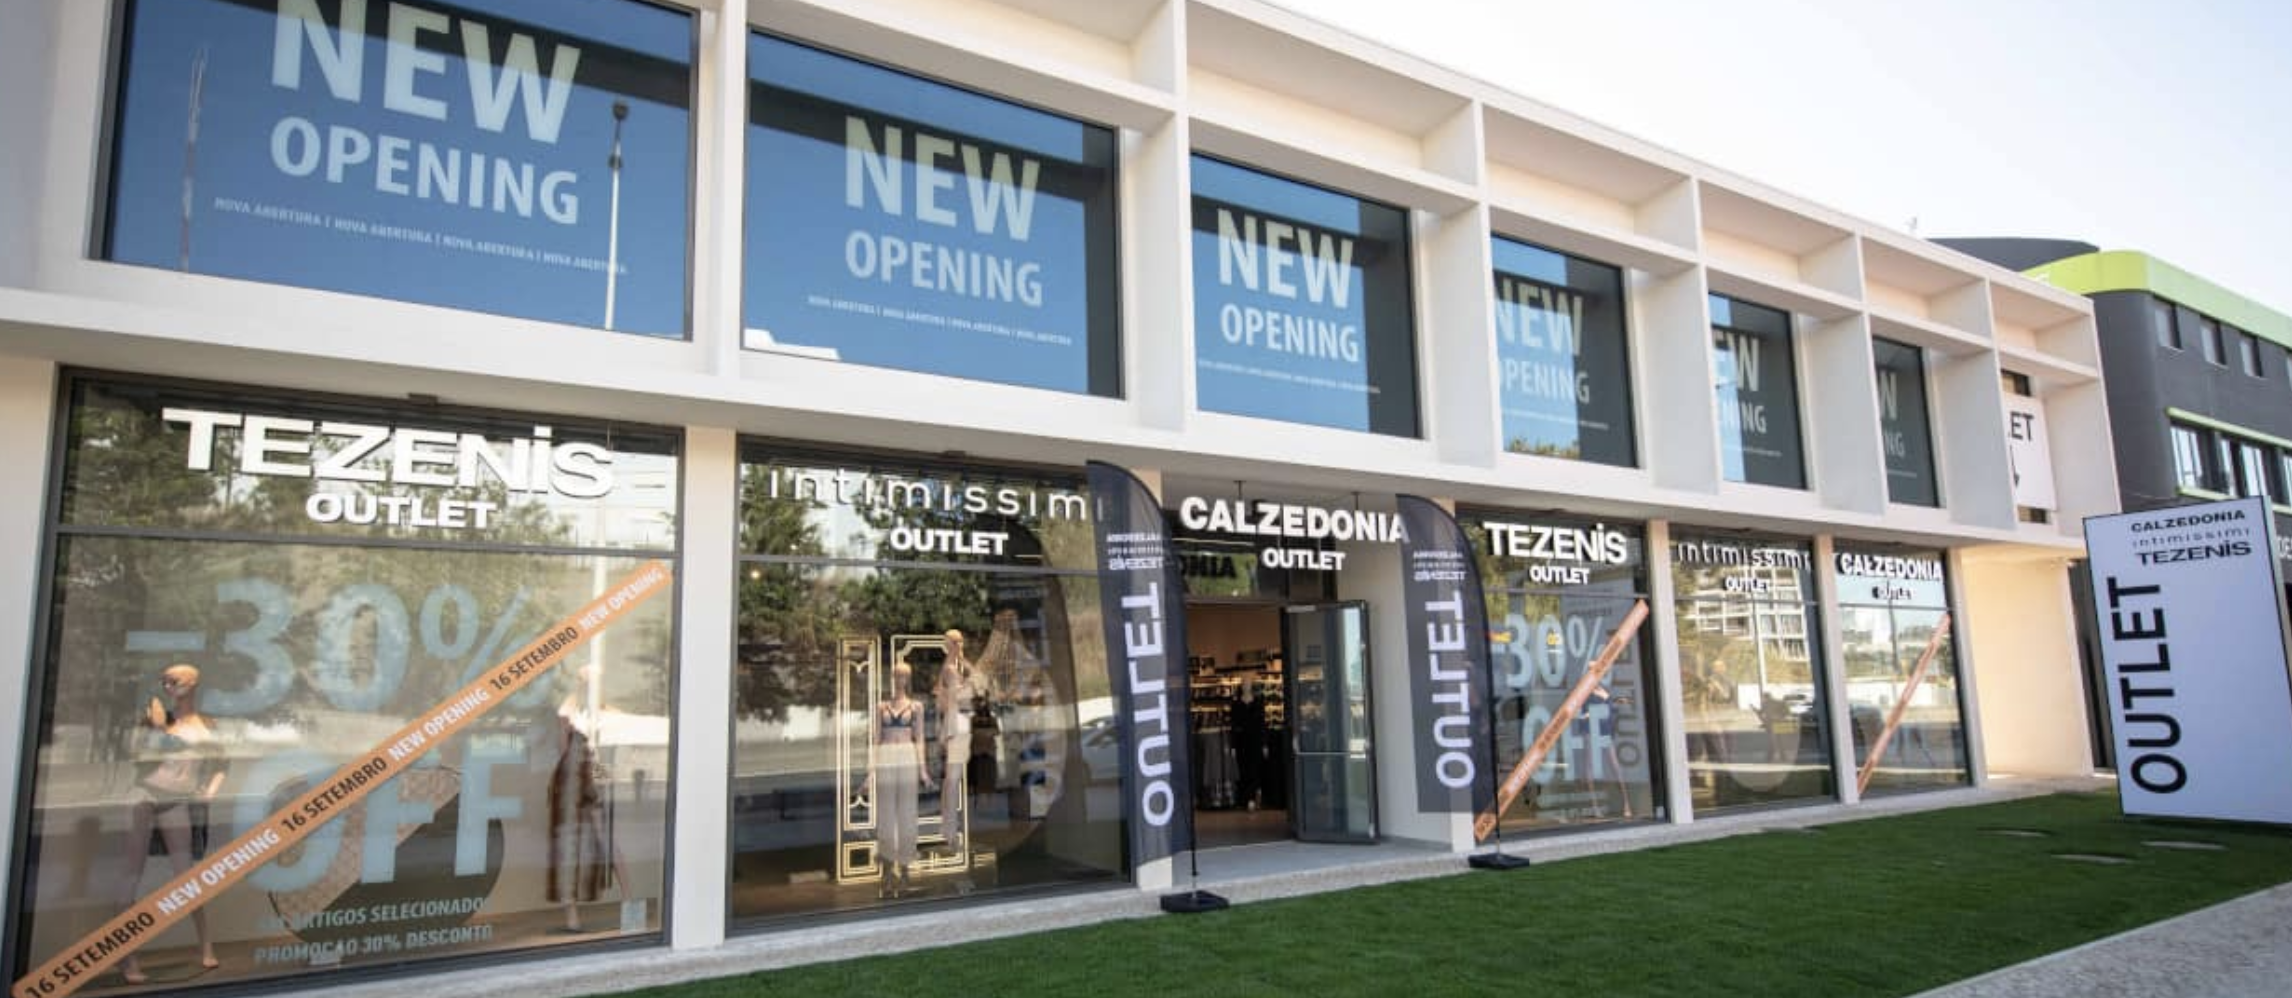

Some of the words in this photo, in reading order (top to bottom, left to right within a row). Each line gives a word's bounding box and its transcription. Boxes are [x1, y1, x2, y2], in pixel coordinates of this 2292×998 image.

[271, 0, 581, 145] NEW
[270, 117, 578, 224] OPENING
[846, 115, 1040, 242] NEW
[214, 197, 250, 213] NOVA
[335, 218, 367, 233] NOVA
[845, 230, 1043, 308] OPENING
[1217, 208, 1353, 309] NEW
[1220, 302, 1359, 362] OPENING
[1499, 357, 1590, 404] PENING
[306, 494, 498, 529] OUTLET
[769, 469, 1103, 521] intimissimi
[890, 525, 1008, 556] OUTLET
[1180, 496, 1410, 544] CALZEDONIA
[2131, 510, 2246, 533] CALZEDONIA
[2132, 527, 2250, 548] intimissimi
[1262, 548, 1347, 571] OUTLET
[1530, 565, 1590, 585] OUTLET
[1678, 541, 1812, 574] intimissimi
[1840, 553, 1943, 580] CALZEDONIA
[2107, 577, 2187, 793] OUTLET
[1523, 704, 1612, 784] OFF
[24, 977, 56, 998] 16
[53, 911, 156, 985] SETEMBRO
[157, 878, 203, 916] NEW
[201, 828, 282, 887] OPENING
[281, 812, 307, 832] 16
[303, 756, 388, 819] SETEMBRO
[388, 729, 426, 761] NEW
[424, 687, 491, 736] OPENING
[489, 672, 512, 690] 16
[508, 626, 579, 679] SETEMBRO
[232, 748, 527, 893] OFF
[361, 934, 400, 955] 30%
[406, 925, 493, 949] DESCONTO
